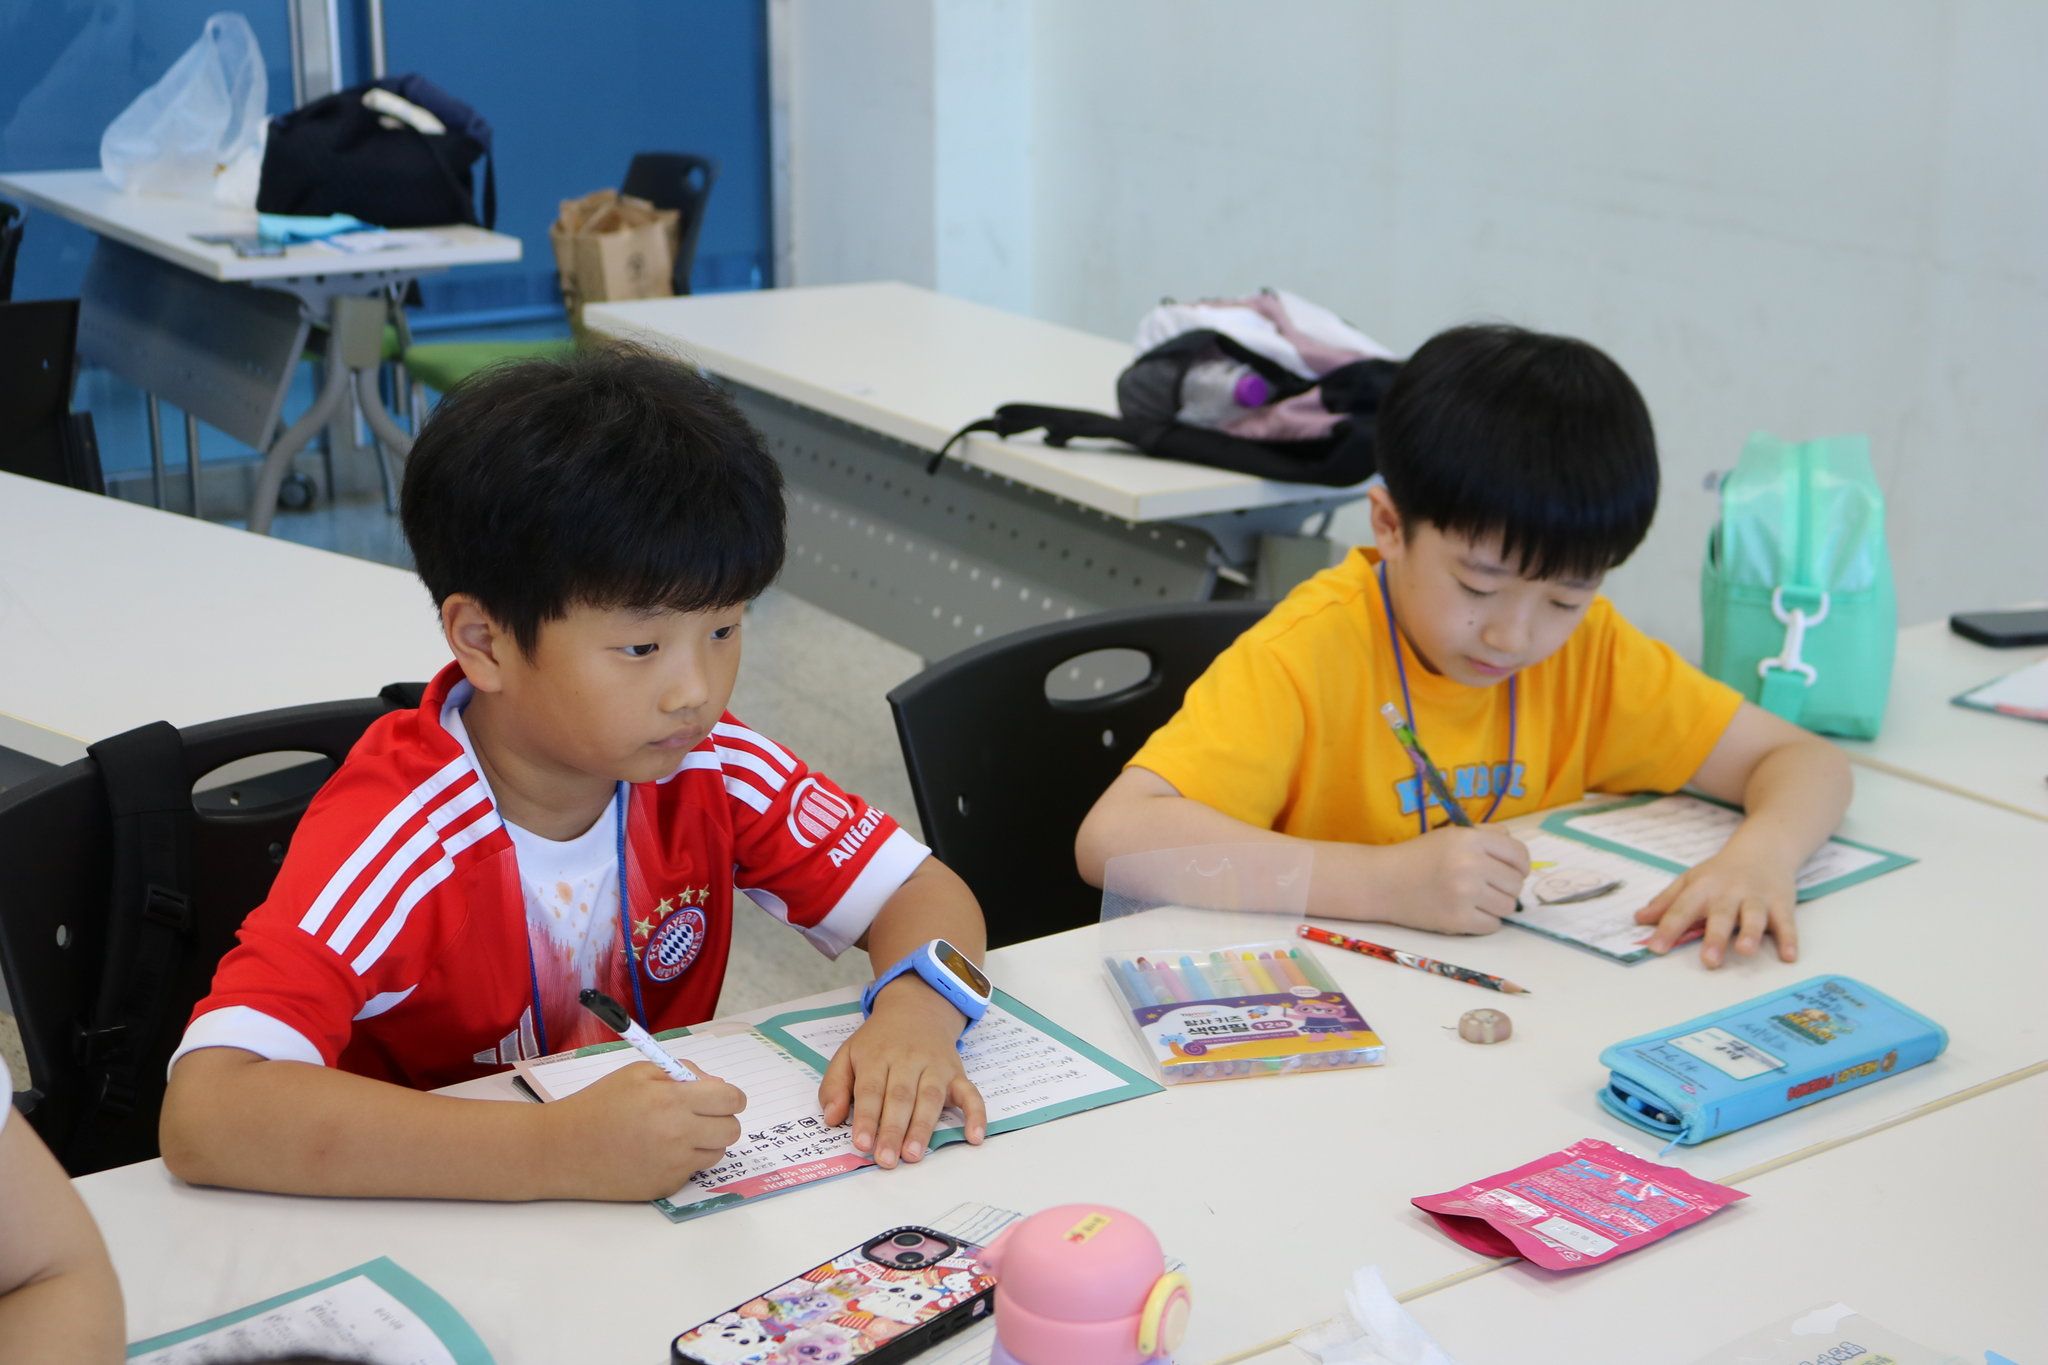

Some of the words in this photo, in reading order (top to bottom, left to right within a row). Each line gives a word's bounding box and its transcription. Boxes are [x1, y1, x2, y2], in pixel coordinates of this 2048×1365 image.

[658, 912, 698, 939] BAYERN
[1188, 1022, 1249, 1036] 색연필
[818, 1164, 847, 1177] 2026
